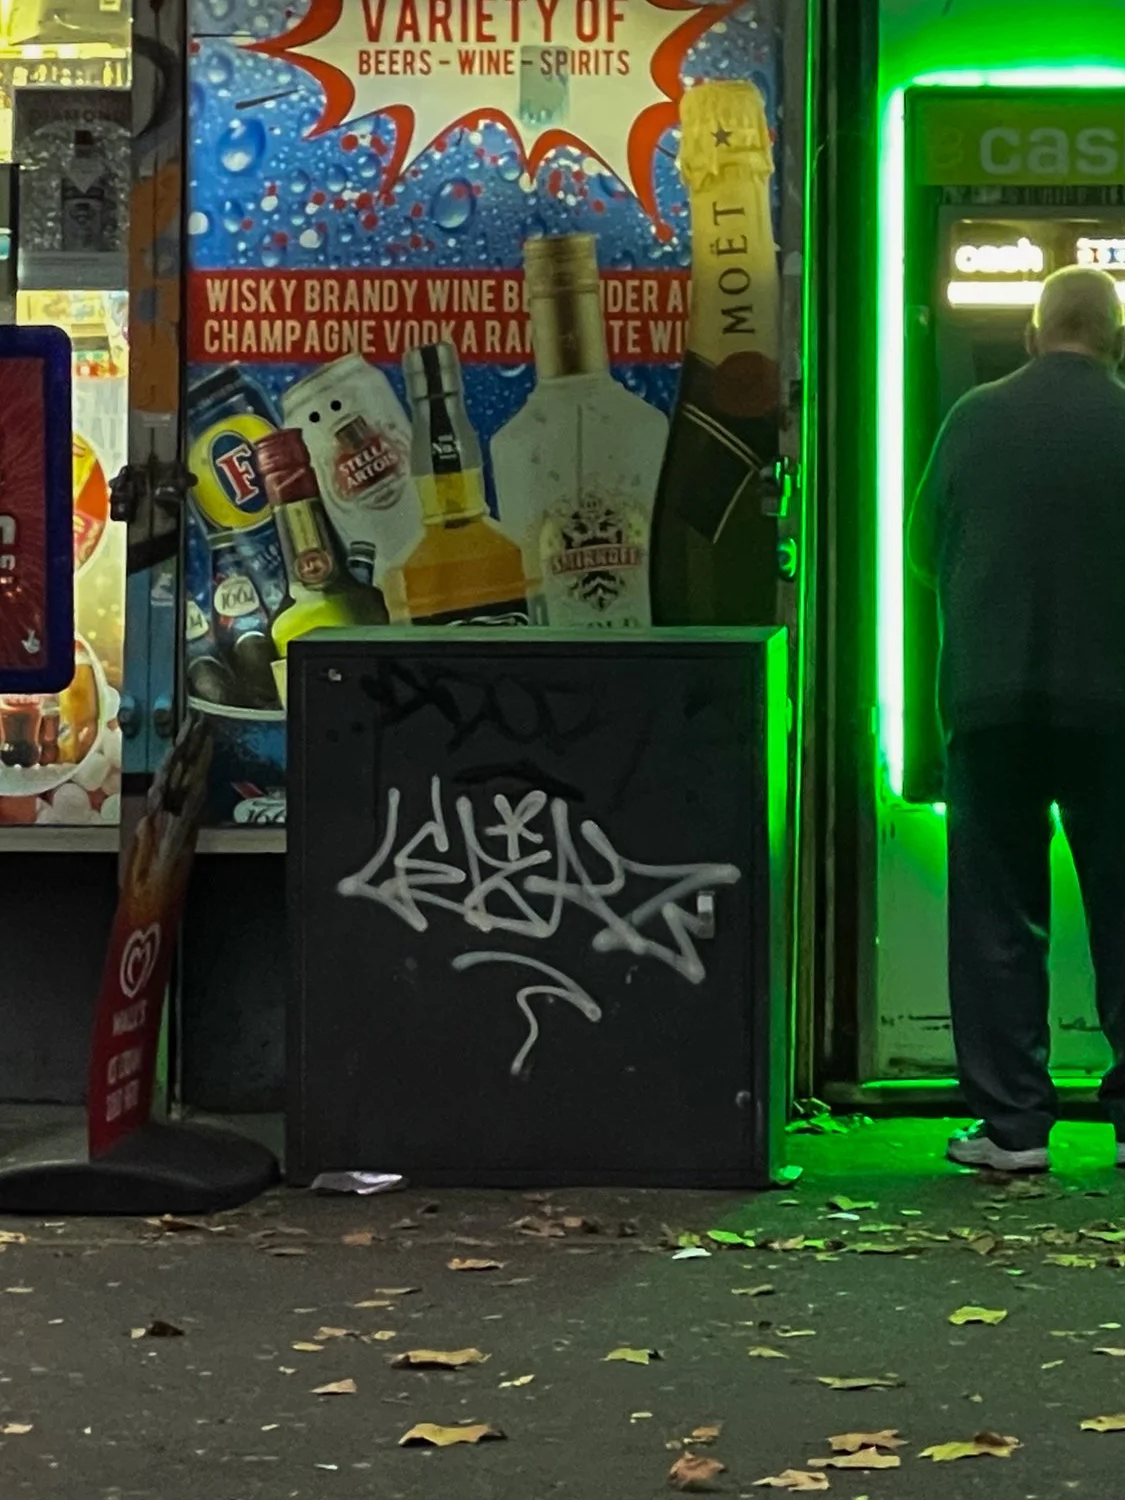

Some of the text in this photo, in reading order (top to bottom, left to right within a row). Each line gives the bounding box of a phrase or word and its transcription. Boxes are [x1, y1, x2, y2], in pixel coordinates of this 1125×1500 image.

[358, 49, 431, 76] BEERS
[457, 49, 515, 75] WINE
[540, 49, 630, 76] SPIRITS
[710, 201, 755, 335] MOËT
[206, 279, 297, 313] WISKY
[304, 279, 418, 313] BRANDY
[426, 279, 496, 313] WINE
[204, 319, 376, 353] CHAMPAGNE
[384, 320, 478, 354] VODKA
[215, 443, 261, 506] F
[338, 442, 390, 474] STELLA
[347, 452, 399, 490] ARTOIS
